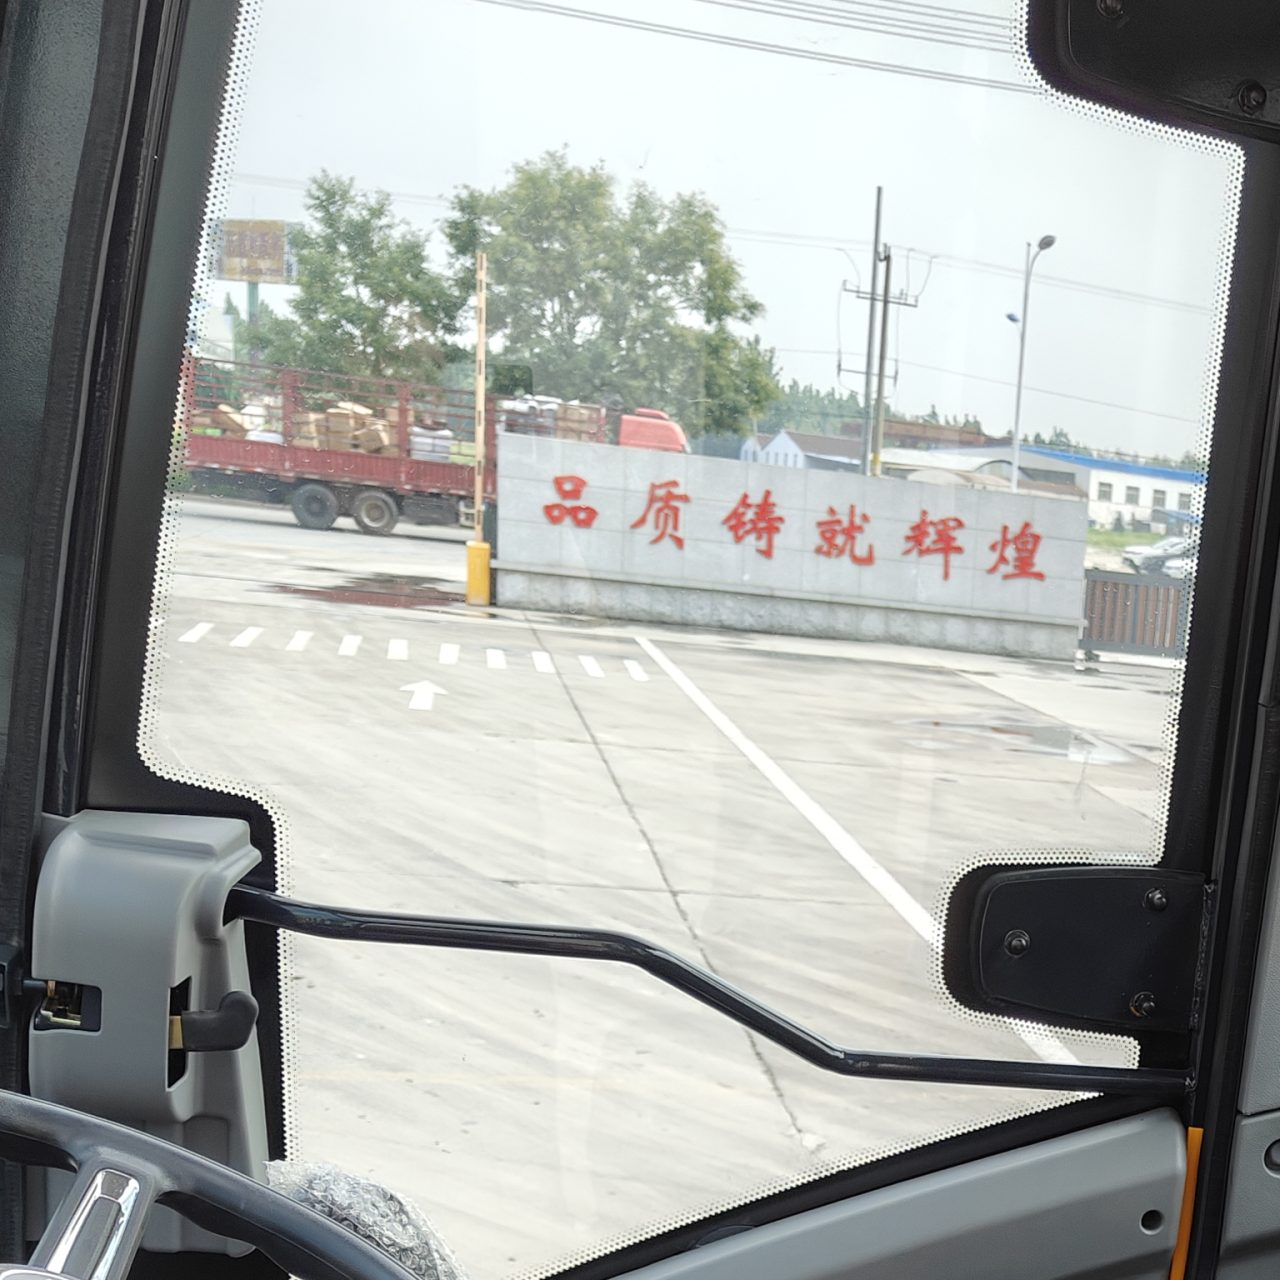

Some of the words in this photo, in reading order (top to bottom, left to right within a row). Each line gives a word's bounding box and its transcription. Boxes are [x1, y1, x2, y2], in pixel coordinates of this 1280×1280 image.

[543, 475, 1046, 582] 品质铸就辉煌
